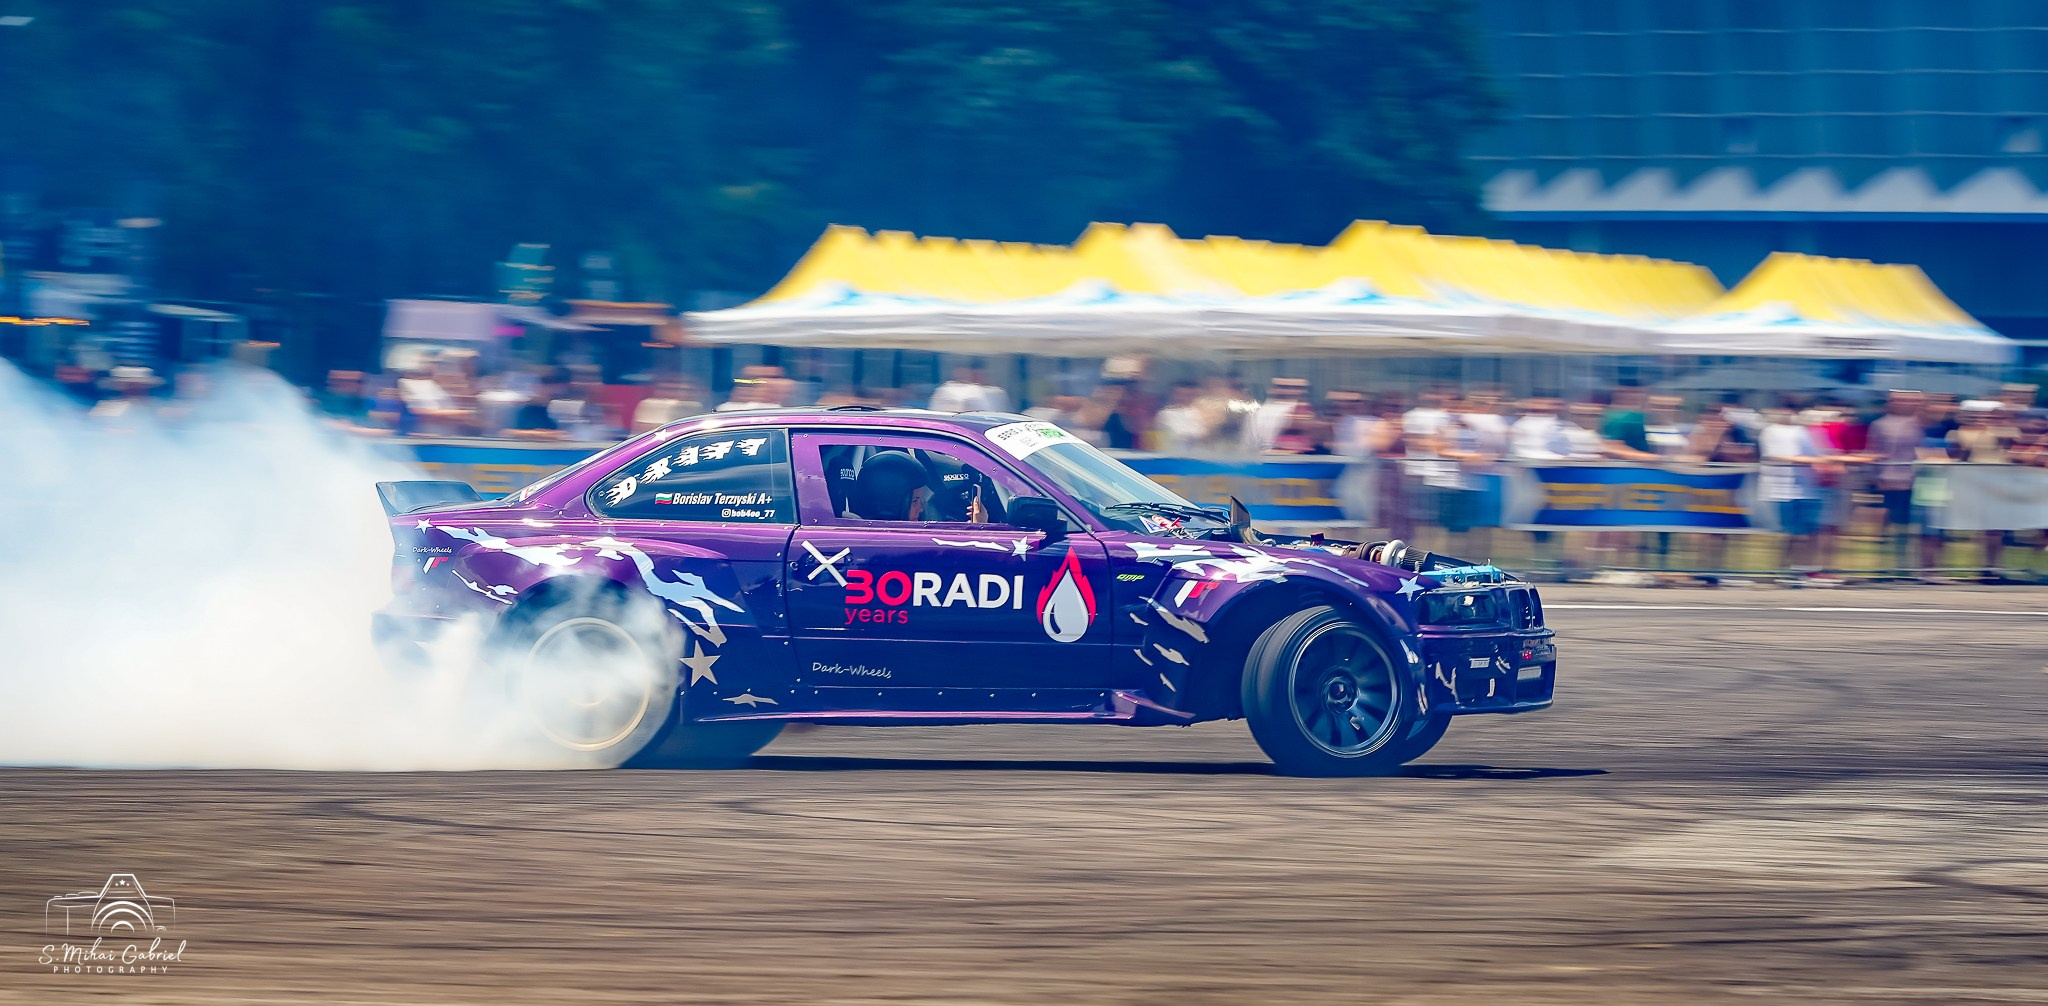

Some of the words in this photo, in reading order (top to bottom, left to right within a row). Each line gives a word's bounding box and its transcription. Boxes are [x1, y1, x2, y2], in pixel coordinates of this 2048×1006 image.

[605, 437, 768, 508] DRIFT
[672, 492, 713, 505] Borislav
[756, 492, 773, 505] A+
[412, 546, 453, 554] Dark-Wheels
[844, 607, 909, 625] years
[812, 662, 892, 679] Dark-Wheels
